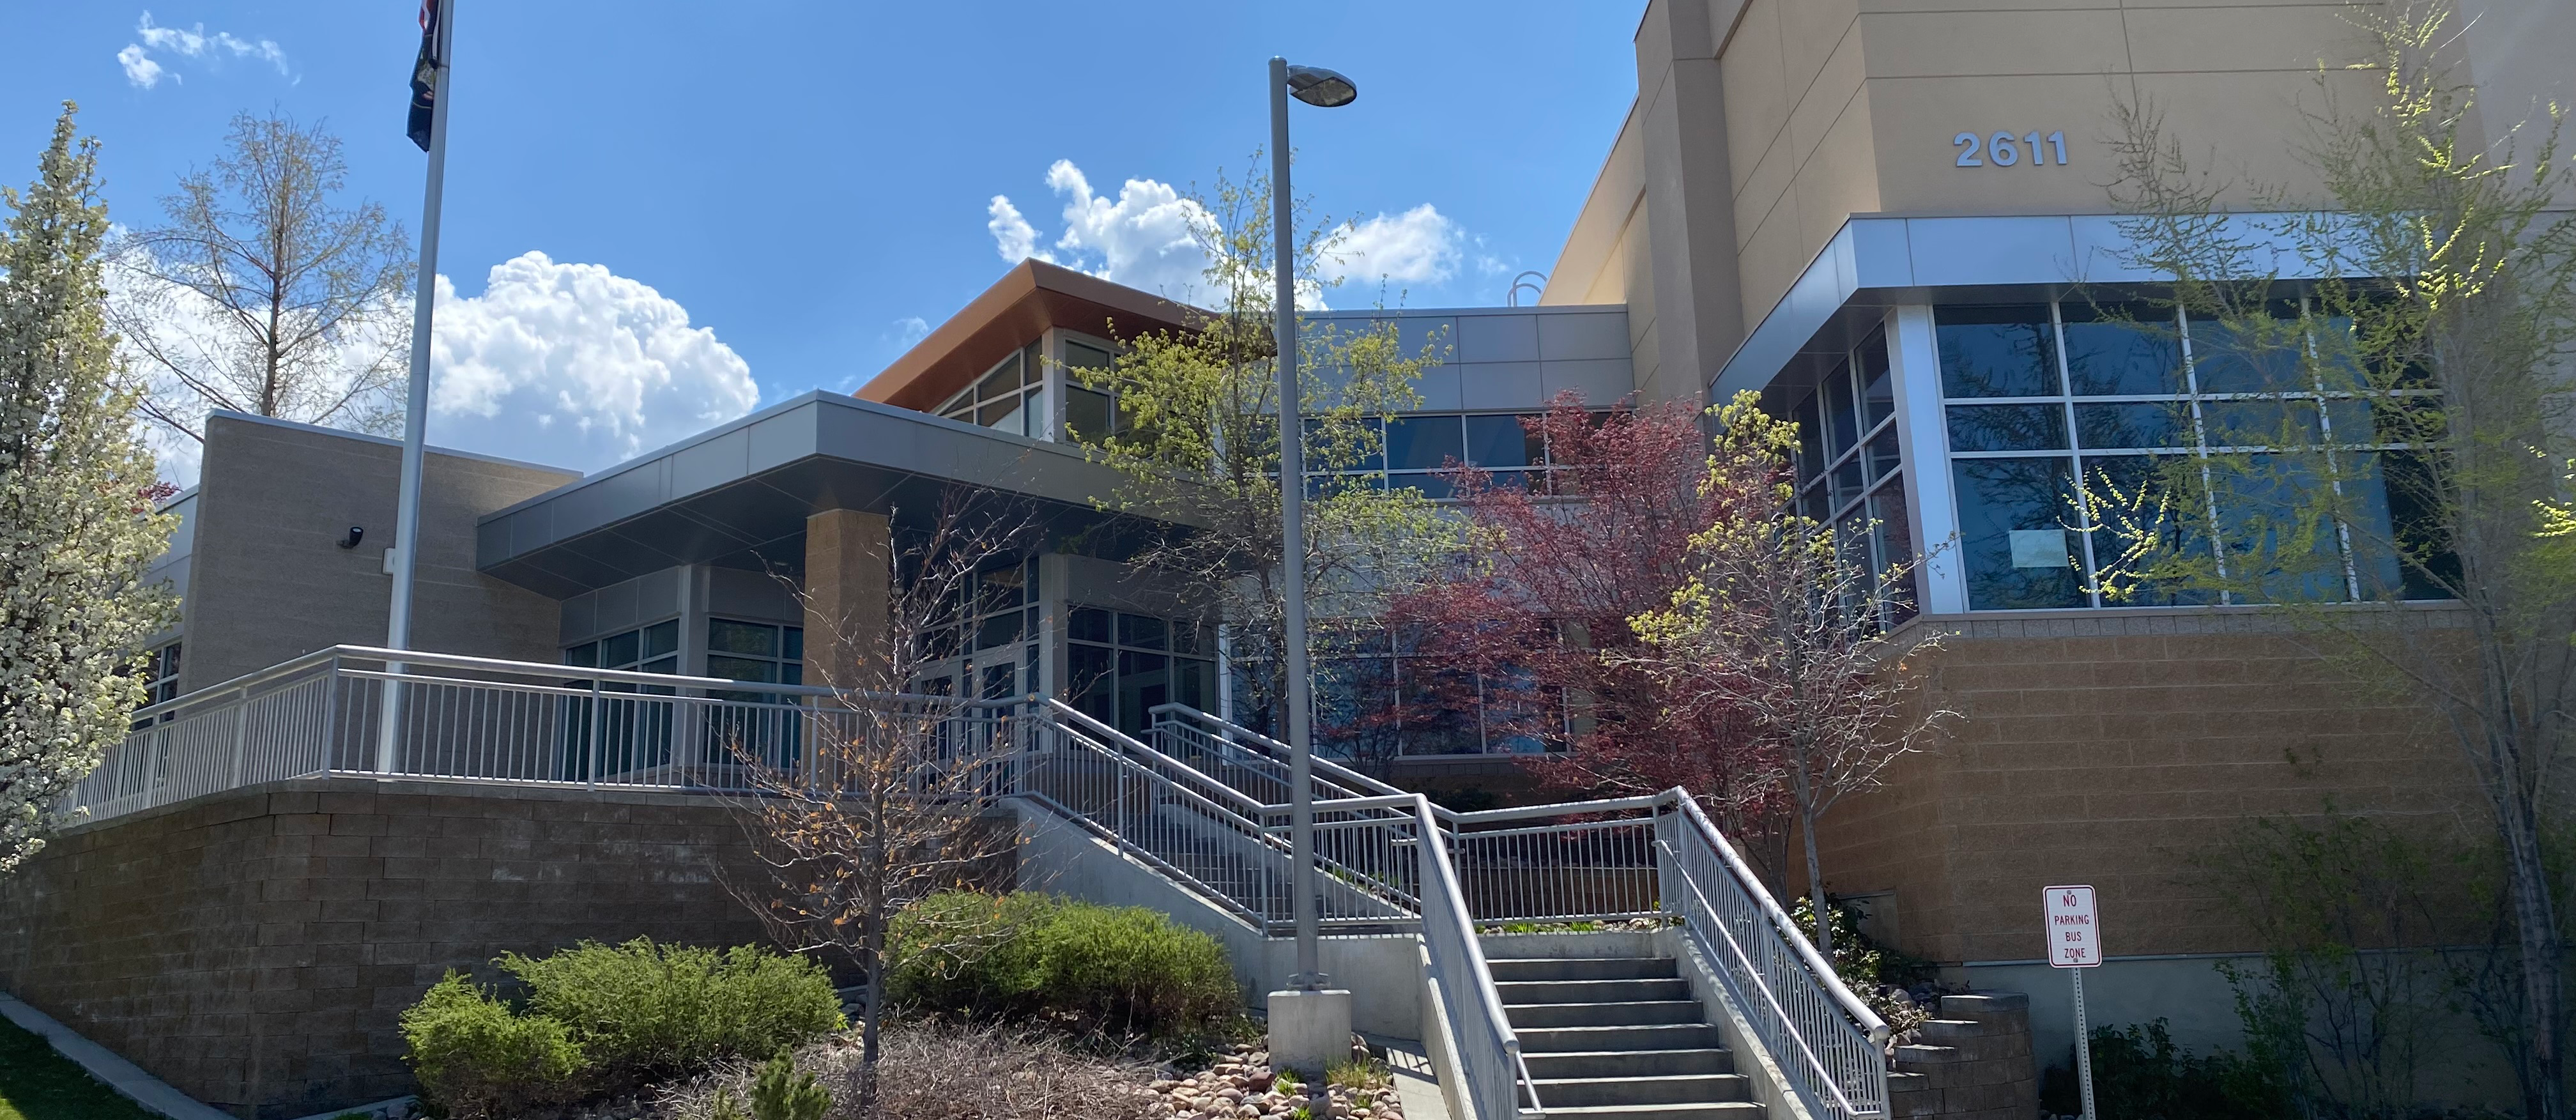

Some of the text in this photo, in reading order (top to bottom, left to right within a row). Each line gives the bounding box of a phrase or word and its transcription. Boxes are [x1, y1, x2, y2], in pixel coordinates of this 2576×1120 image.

[1954, 130, 2067, 167] 2611
[2063, 894, 2077, 907] NO
[2054, 914, 2089, 925] PARKING
[2065, 931, 2082, 942] BUS
[2064, 947, 2086, 958] ZONE
